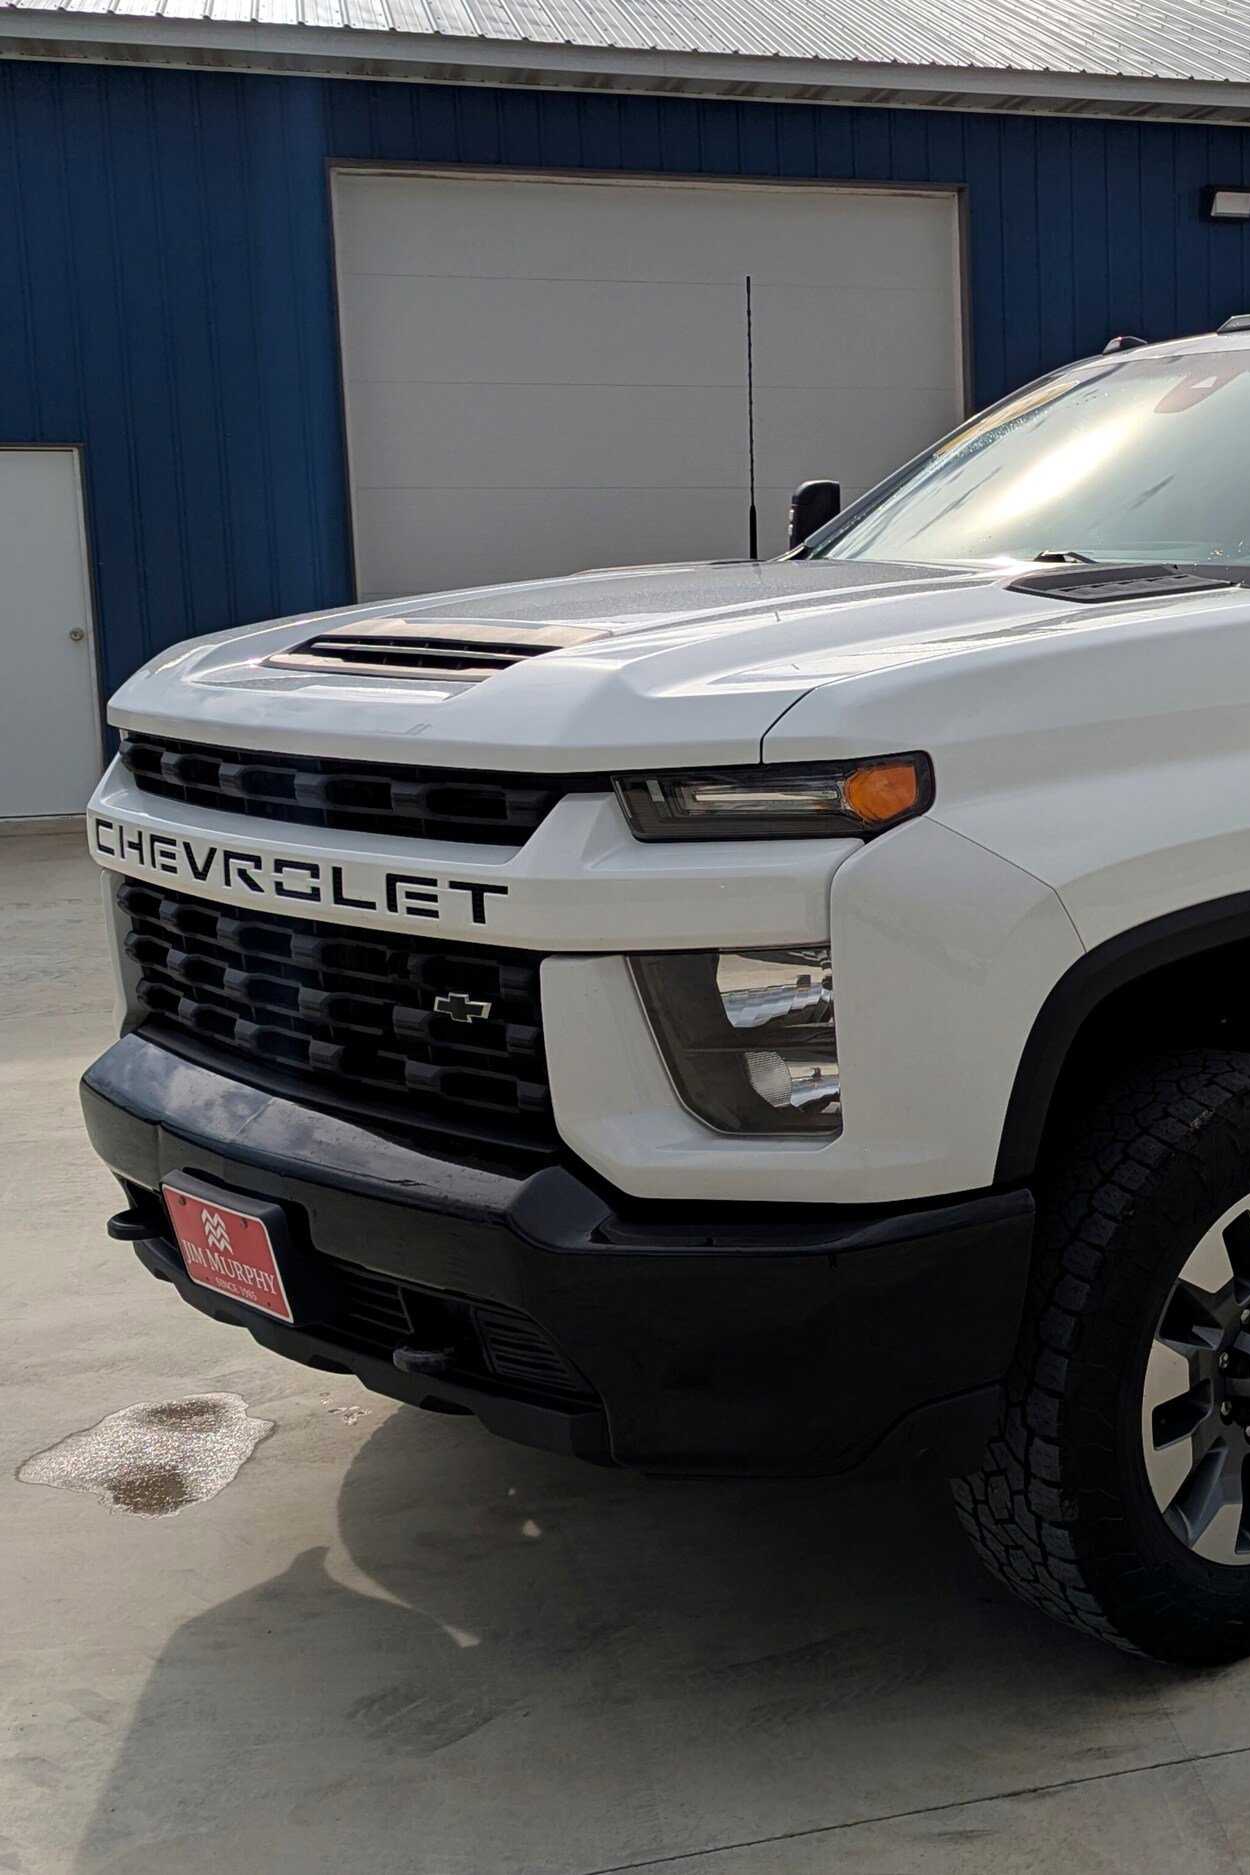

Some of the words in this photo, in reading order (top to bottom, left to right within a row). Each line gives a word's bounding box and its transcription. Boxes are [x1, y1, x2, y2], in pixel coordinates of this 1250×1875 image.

[95, 818, 508, 924] CHEVROLET
[181, 1239, 208, 1267] JIM
[205, 1249, 277, 1295] MURPHY
[215, 1277, 240, 1294] SINCE
